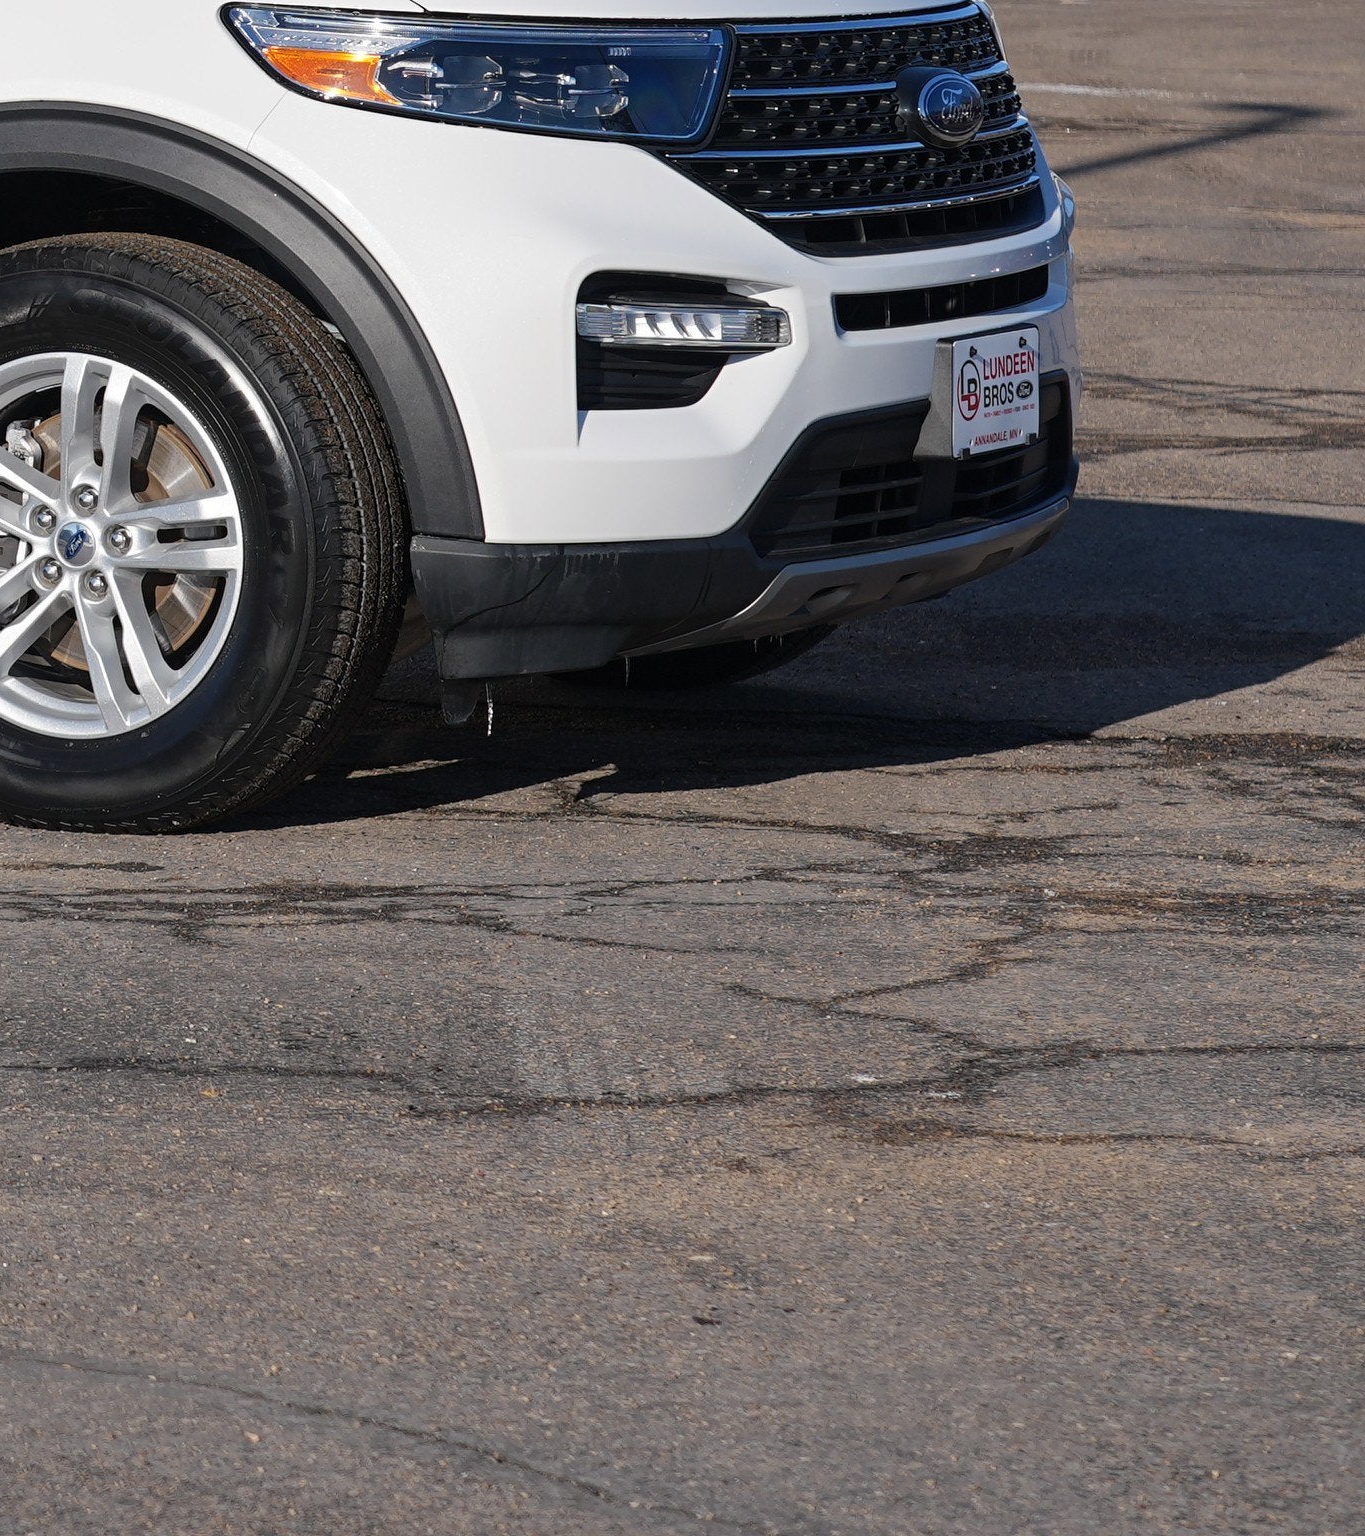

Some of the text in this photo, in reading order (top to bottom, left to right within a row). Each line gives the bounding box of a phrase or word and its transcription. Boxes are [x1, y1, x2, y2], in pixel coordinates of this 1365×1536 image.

[941, 88, 974, 124] Ford
[983, 351, 1035, 380] LUNDEEN
[983, 382, 1014, 408] BROS
